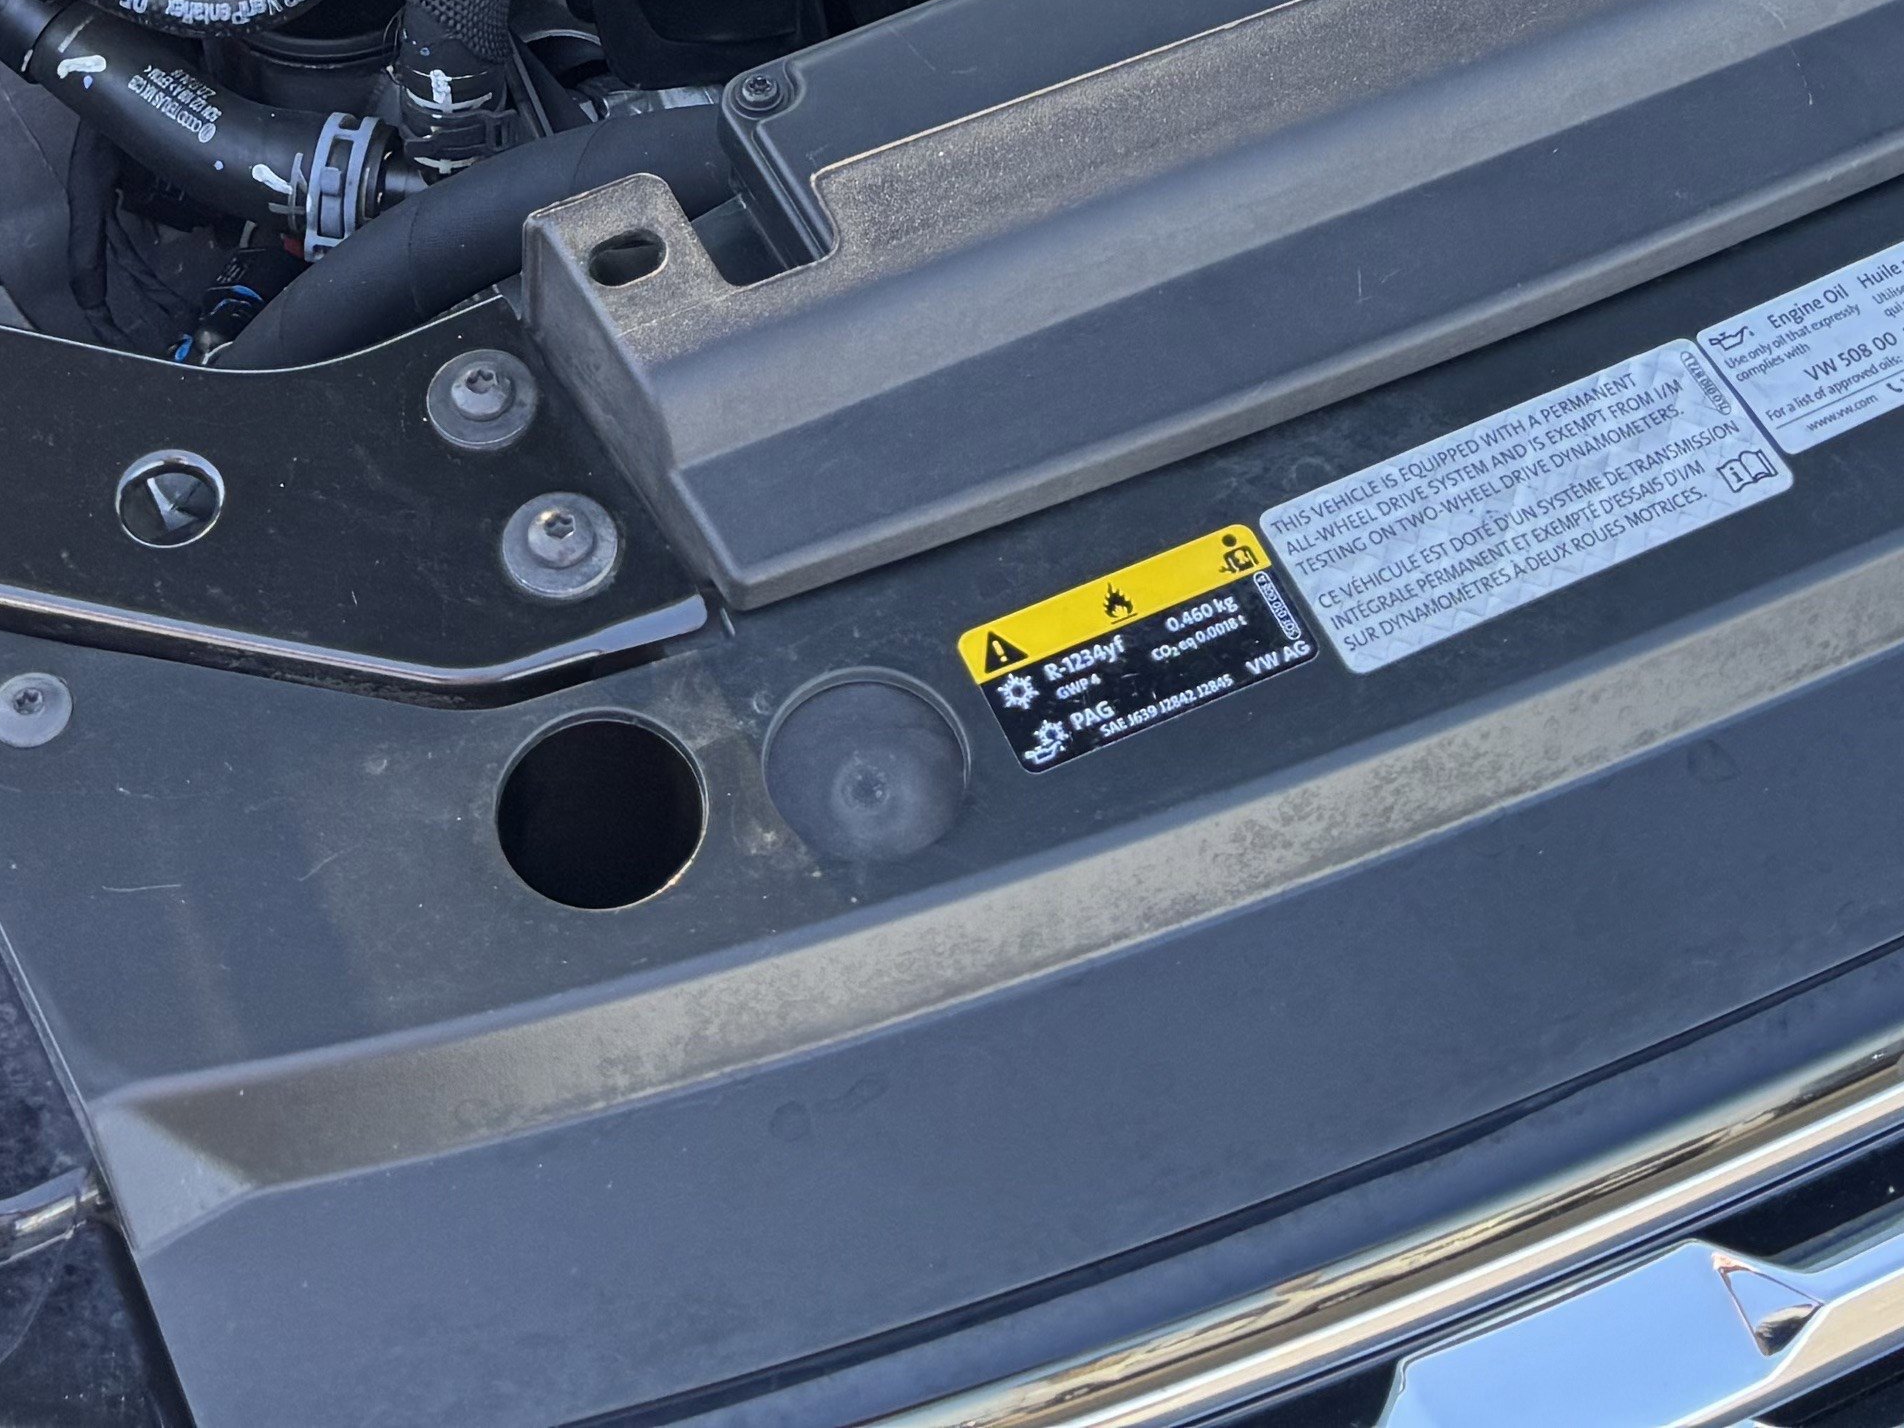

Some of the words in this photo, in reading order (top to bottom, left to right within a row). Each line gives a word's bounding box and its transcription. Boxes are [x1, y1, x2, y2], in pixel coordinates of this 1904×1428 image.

[1856, 263, 1902, 289] Huile
[1766, 298, 1825, 329] Engine
[1822, 282, 1849, 304] Oil
[1883, 301, 1904, 319] qui
[1723, 354, 1749, 369] Use
[1747, 343, 1773, 360] only
[1771, 334, 1787, 349] oil
[1784, 325, 1812, 342] that
[1810, 303, 1861, 331] expressly
[1803, 357, 1838, 381] VW
[1837, 342, 1873, 367] 508
[1871, 331, 1898, 351] 00
[1735, 354, 1785, 382] complies
[1783, 343, 1811, 360] with
[1764, 406, 1787, 421] For
[1786, 402, 1797, 413] a
[1792, 393, 1815, 409] list
[1813, 385, 1827, 400] of
[1827, 363, 1879, 395] approved
[1878, 355, 1903, 371] oils:
[1806, 394, 1878, 431] www.vw.com
[1270, 509, 1312, 534] THIS
[1310, 479, 1381, 518] VEHICLE
[1379, 472, 1399, 489] IS
[1398, 439, 1480, 482] EQUIPPED
[1479, 419, 1526, 447] WITH
[1527, 414, 1542, 429] A
[1539, 372, 1636, 422] PERMANENT
[1286, 508, 1378, 556] ALL-WHEEL
[1375, 485, 1429, 516] DRIVE
[1427, 459, 1490, 495] SYSTEM
[1491, 443, 1527, 468] AND
[1527, 435, 1546, 452] IS
[1544, 408, 1607, 445] EXEMPT
[1607, 390, 1655, 419] FROM
[1653, 378, 1683, 400] I/M
[1294, 536, 1367, 575] TESTING
[1368, 524, 1397, 545] ON
[1395, 481, 1501, 531] TWO-WHEEL
[1498, 458, 1551, 490] DRIVE
[1549, 403, 1684, 468] DYNAMOMETERS.
[1317, 589, 1342, 609] CE
[1338, 553, 1421, 598] VÉHICULE
[1419, 541, 1448, 564] EST
[1448, 519, 1496, 553] DOTÉ
[1489, 505, 1538, 532] D'UN
[1536, 475, 1605, 515] SYSTÈME
[1601, 466, 1629, 486] DE
[1625, 420, 1740, 475] TRANSMISSION
[1330, 583, 1418, 630] INTÉGRALE
[1415, 540, 1511, 592] PERMANENT
[1510, 532, 1532, 552] ET
[1530, 500, 1600, 543] EXEMPTÉ
[1598, 476, 1664, 515] D'ESSAIS
[1662, 459, 1706, 487] D'I/M
[1343, 626, 1380, 652] SUR
[1378, 568, 1511, 636] DYNAMOMÈTRES
[1509, 559, 1528, 579] À
[1524, 542, 1573, 572] DEUX
[1570, 518, 1626, 552] ROUES
[1623, 486, 1708, 528] MOTRICES.
[1165, 603, 1213, 632] 0.460
[1212, 596, 1239, 613] kg
[1194, 617, 1239, 643] 0.0018
[1043, 634, 1125, 681] R-1234yf
[1244, 650, 1279, 675] VW
[1282, 639, 1311, 662] AG
[1055, 677, 1089, 699] GWP
[1090, 672, 1102, 685] 4
[1099, 717, 1128, 737] SAE
[1158, 689, 1197, 713] J2842
[1196, 673, 1234, 698] J2845
[1069, 700, 1115, 730] PAG
